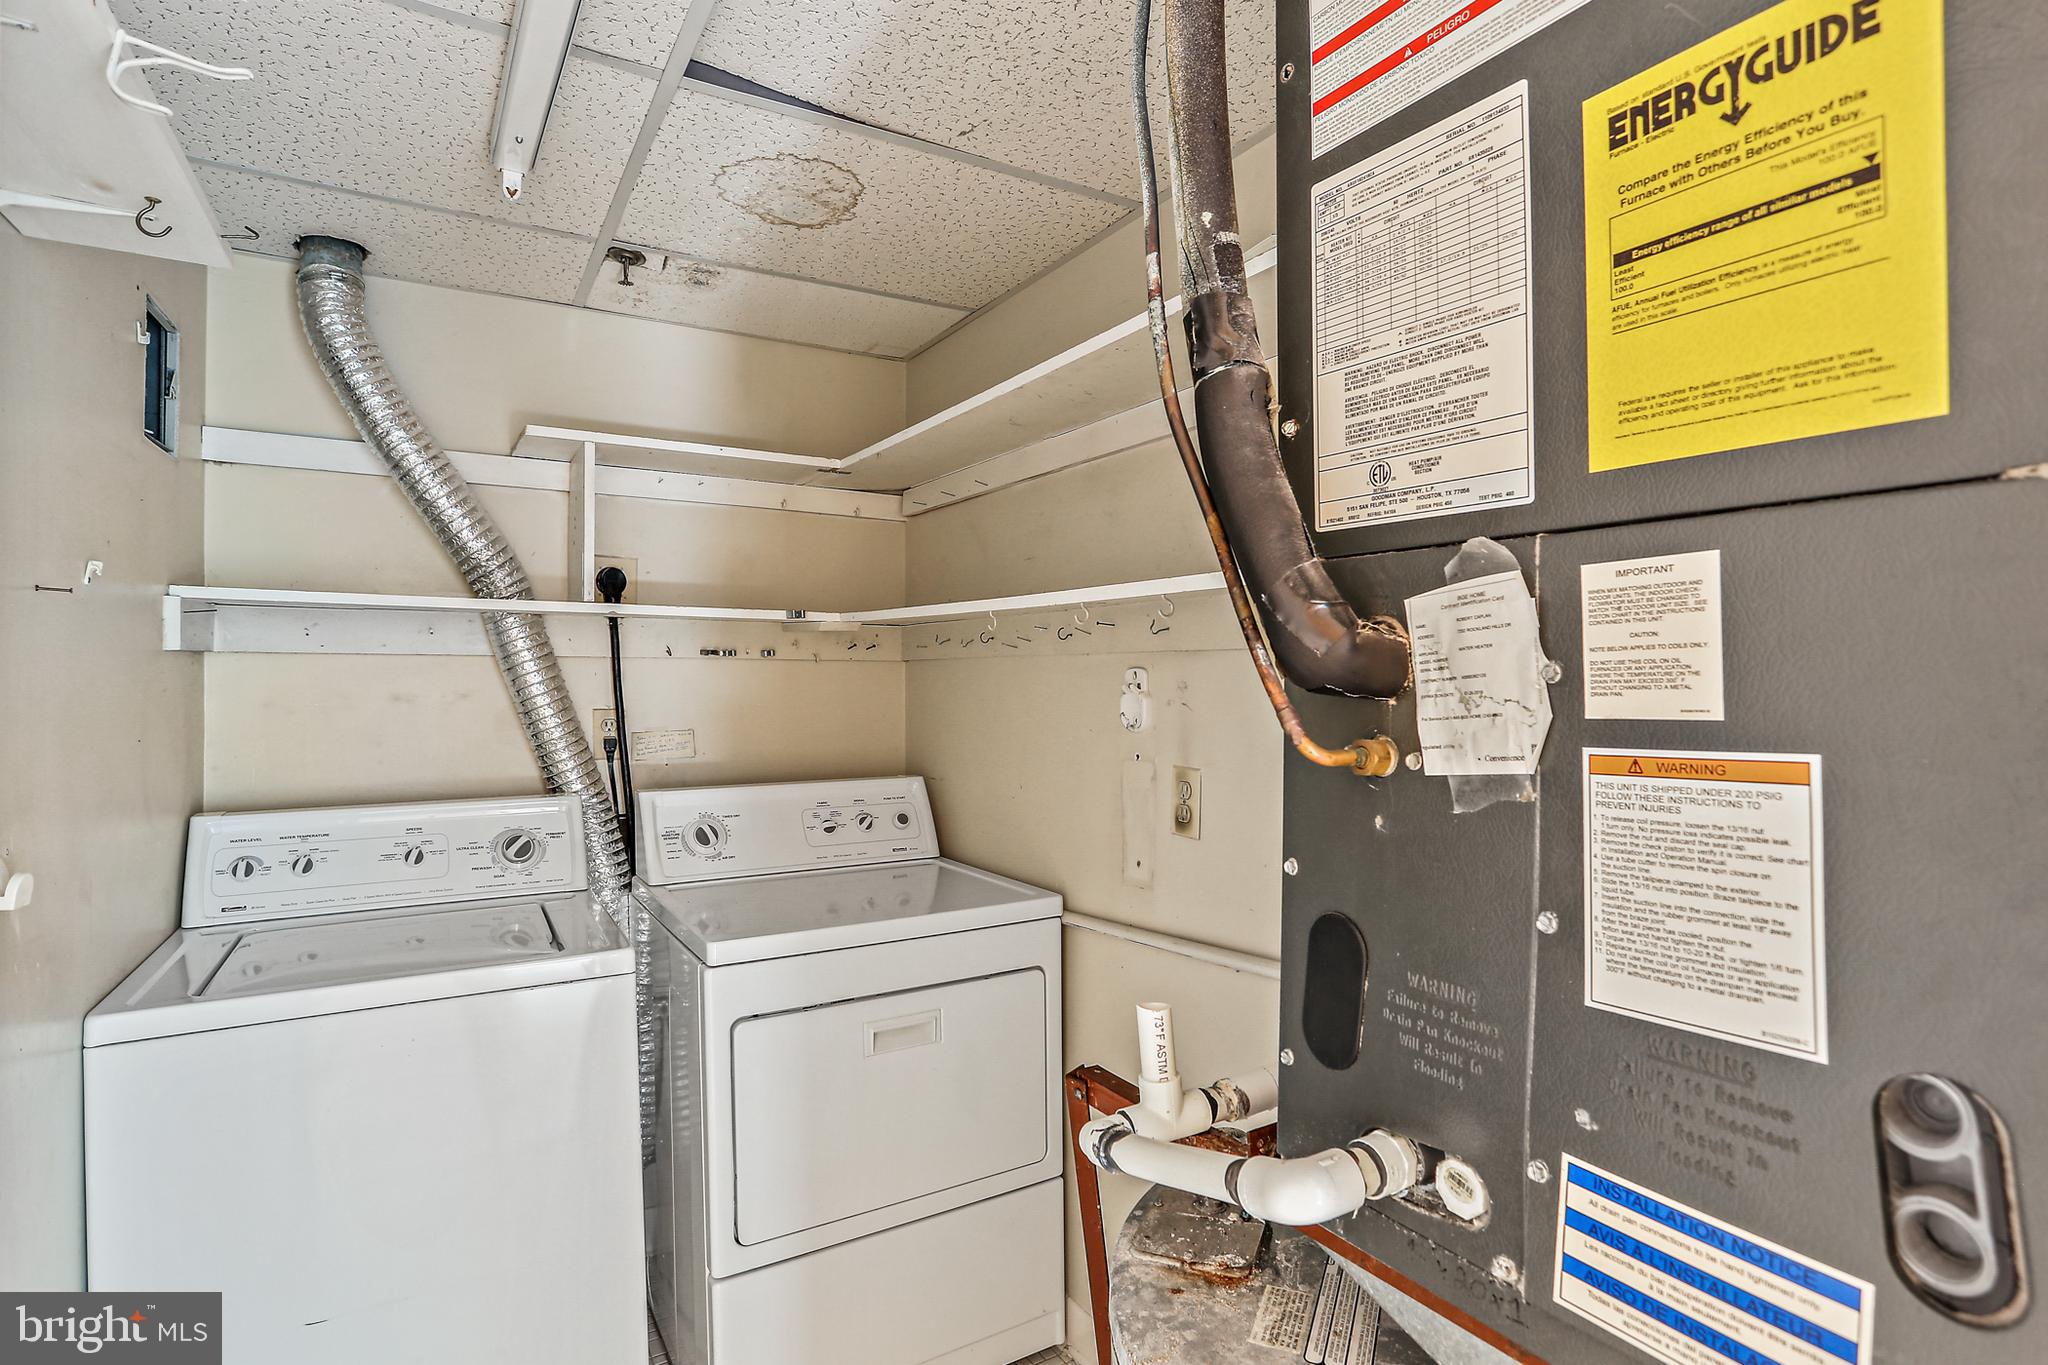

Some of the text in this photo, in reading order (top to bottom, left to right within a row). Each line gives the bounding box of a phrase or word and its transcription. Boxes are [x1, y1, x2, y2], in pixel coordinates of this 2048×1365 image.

[1427, 8, 1469, 44] PELIGRO
[1608, 0, 1880, 152] ENERGYGUIDE
[1487, 150, 1506, 162] PHASE
[1609, 141, 1638, 160] Furnace
[1646, 125, 1673, 144] Electric
[1618, 86, 1866, 197] Compare the Energy Efficiency of this
[1620, 103, 1864, 210] Furnace with Others Before You Buy.
[1632, 240, 1663, 261] Energy
[1664, 224, 1709, 250] efficiency
[1712, 214, 1739, 234] range
[1741, 209, 1753, 224] of
[1754, 204, 1767, 219] all
[1614, 265, 1633, 278] Least
[1614, 270, 1644, 286] Efficient
[1614, 282, 1633, 295] 100.0
[1634, 293, 1658, 307] Annual
[1661, 288, 1676, 300] Fuel
[1678, 275, 1716, 294] Utilization
[1370, 500, 1387, 508] FELIPE,
[1417, 491, 1442, 501] HOUSTON,
[1615, 564, 1673, 577] IMPORTANT
[1656, 762, 1726, 775] WARNING
[1595, 781, 1614, 789] THIS
[1616, 783, 1636, 791] UNIT
[1639, 784, 1648, 792] IS
[1651, 785, 1692, 795] SHIPPED
[1695, 787, 1731, 797] UNDER
[1735, 790, 1752, 799] 200
[1596, 791, 1760, 810] FOLLOW THESE INSTRUCTIONS TO
[1596, 800, 1681, 814] PREVENT INJURIES
[1408, 971, 1476, 1008] WARNING
[1157, 1044, 1168, 1074] ASTM
[1593, 1176, 1817, 1289] INSTALLATION NOTICE
[1584, 1268, 1640, 1308] AVISO
[1642, 1297, 1668, 1323] DE
[1588, 1222, 1626, 1252] AVIS
[1649, 1252, 1823, 1347] L'INSTALLATEUR
